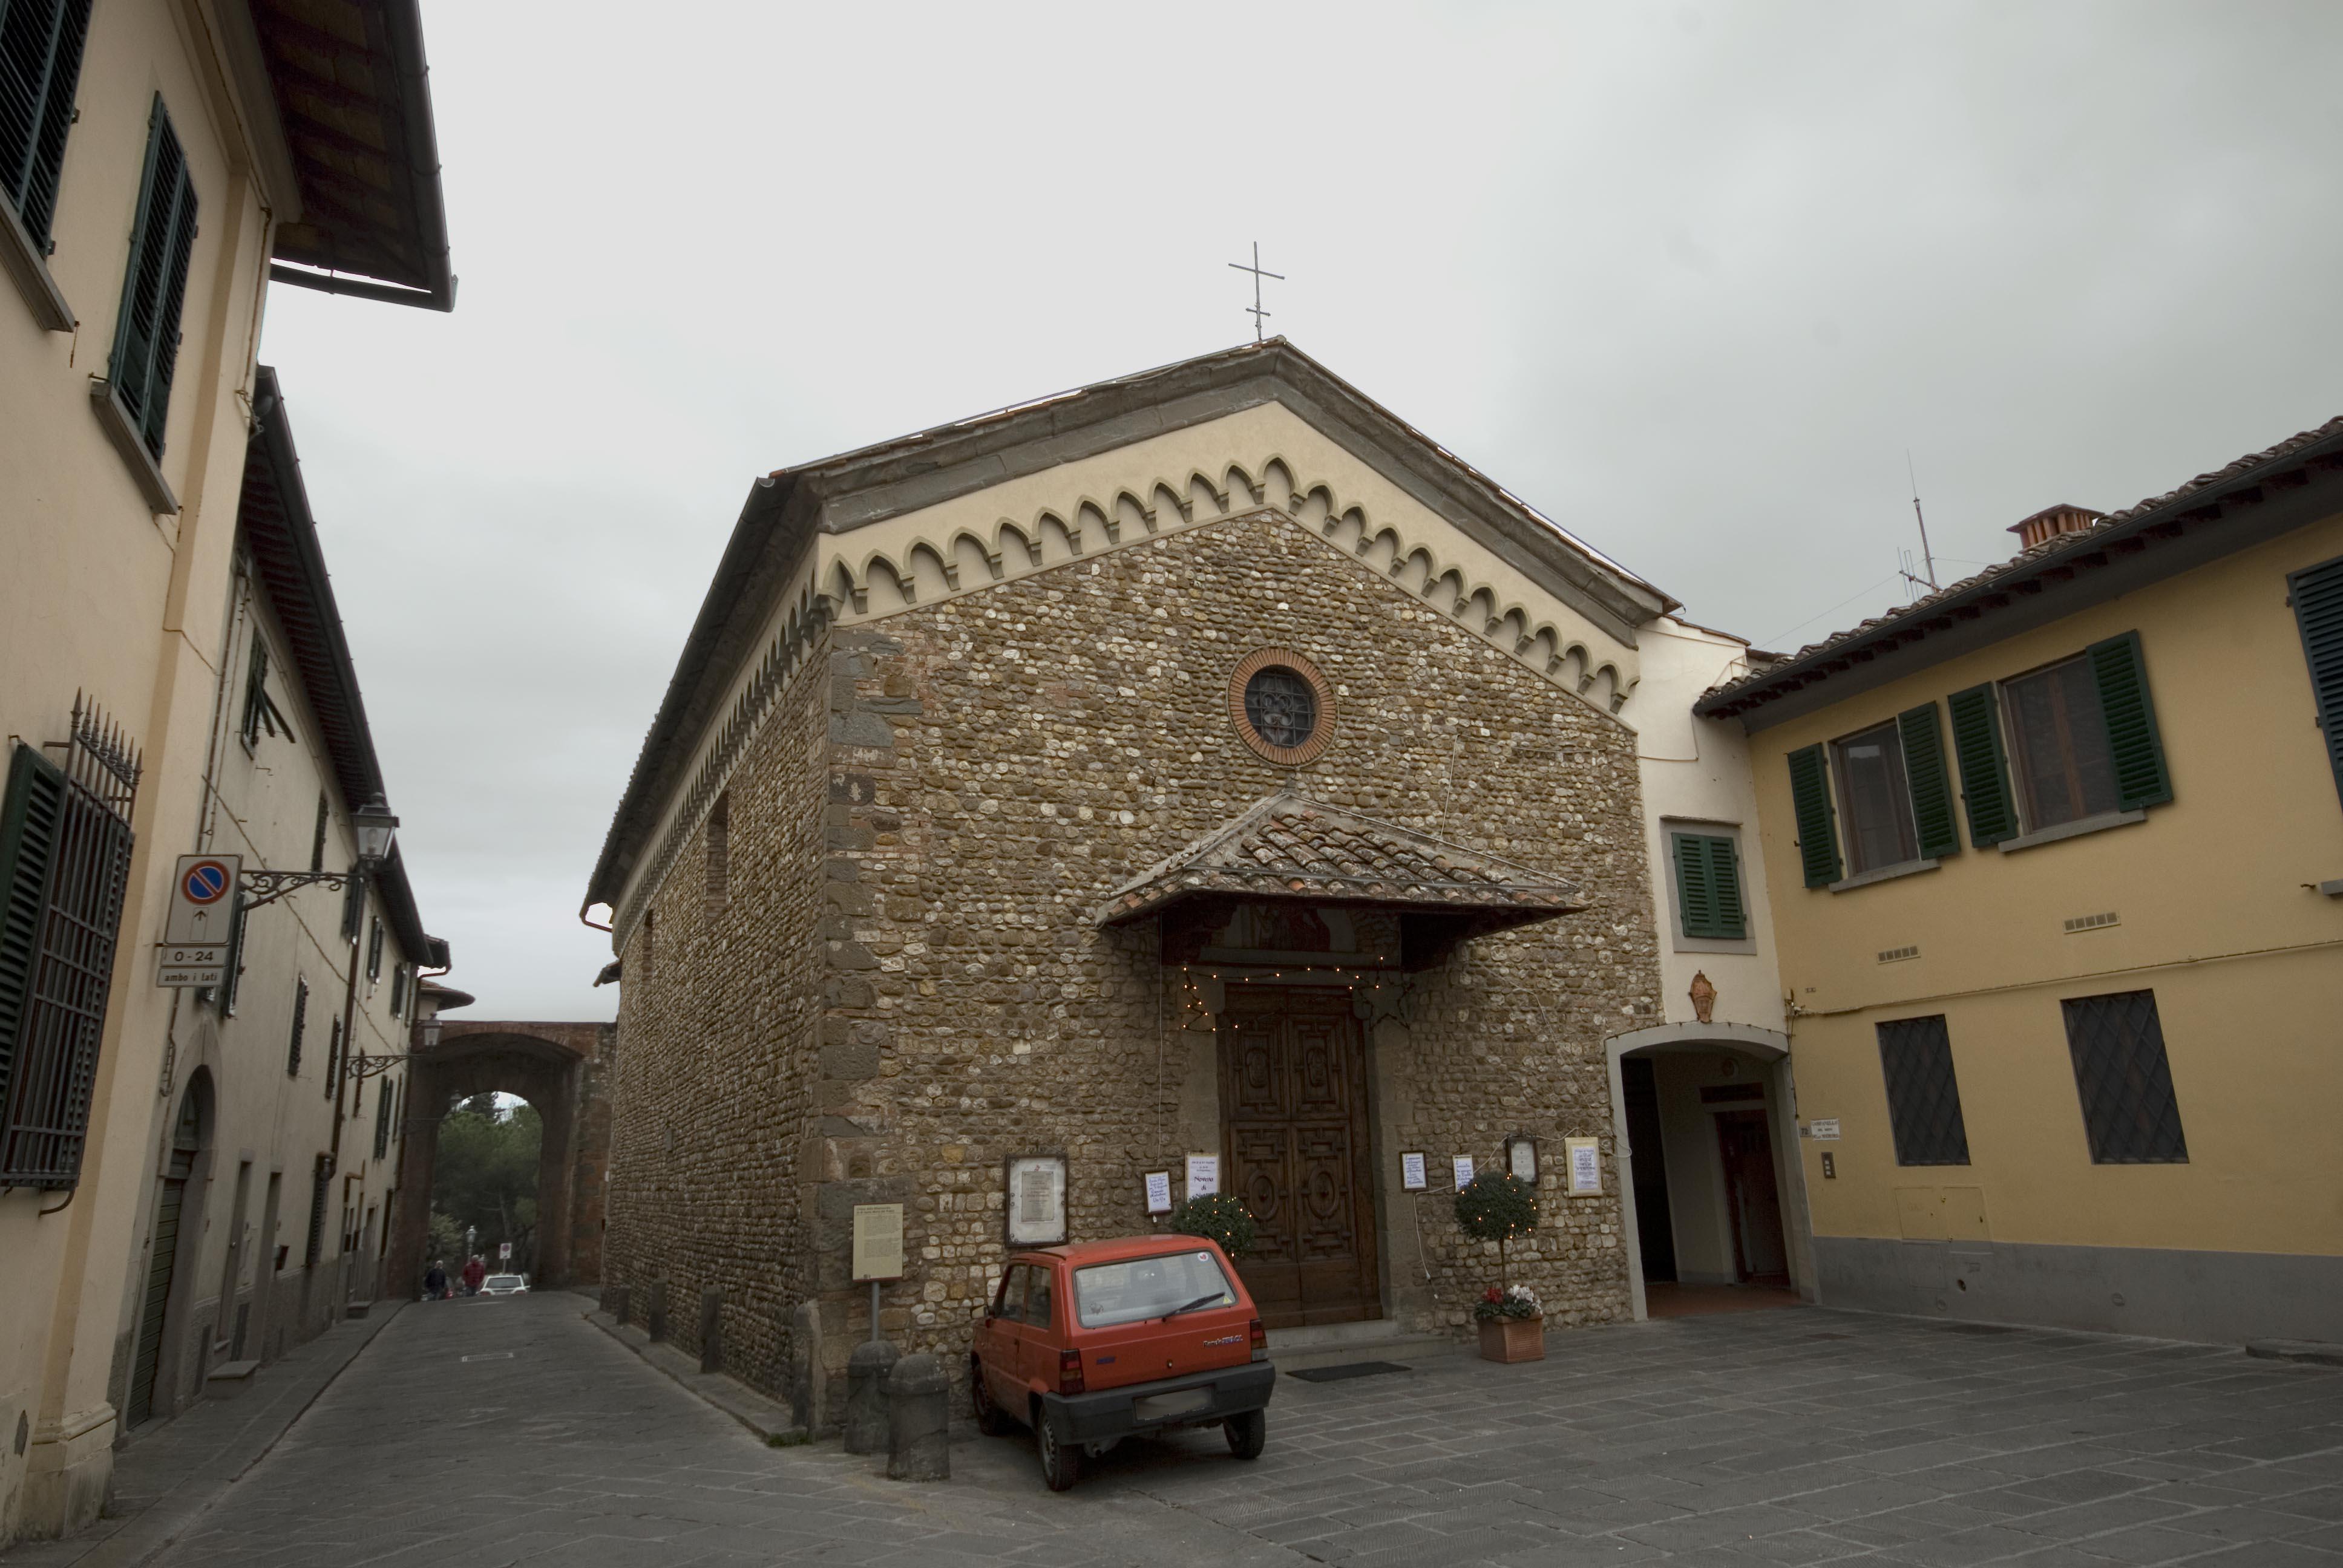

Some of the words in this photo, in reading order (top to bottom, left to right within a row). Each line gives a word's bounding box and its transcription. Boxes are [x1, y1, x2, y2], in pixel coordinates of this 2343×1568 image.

[165, 973, 188, 981] ambo
[193, 973, 197, 981] i
[202, 972, 217, 981] lati
